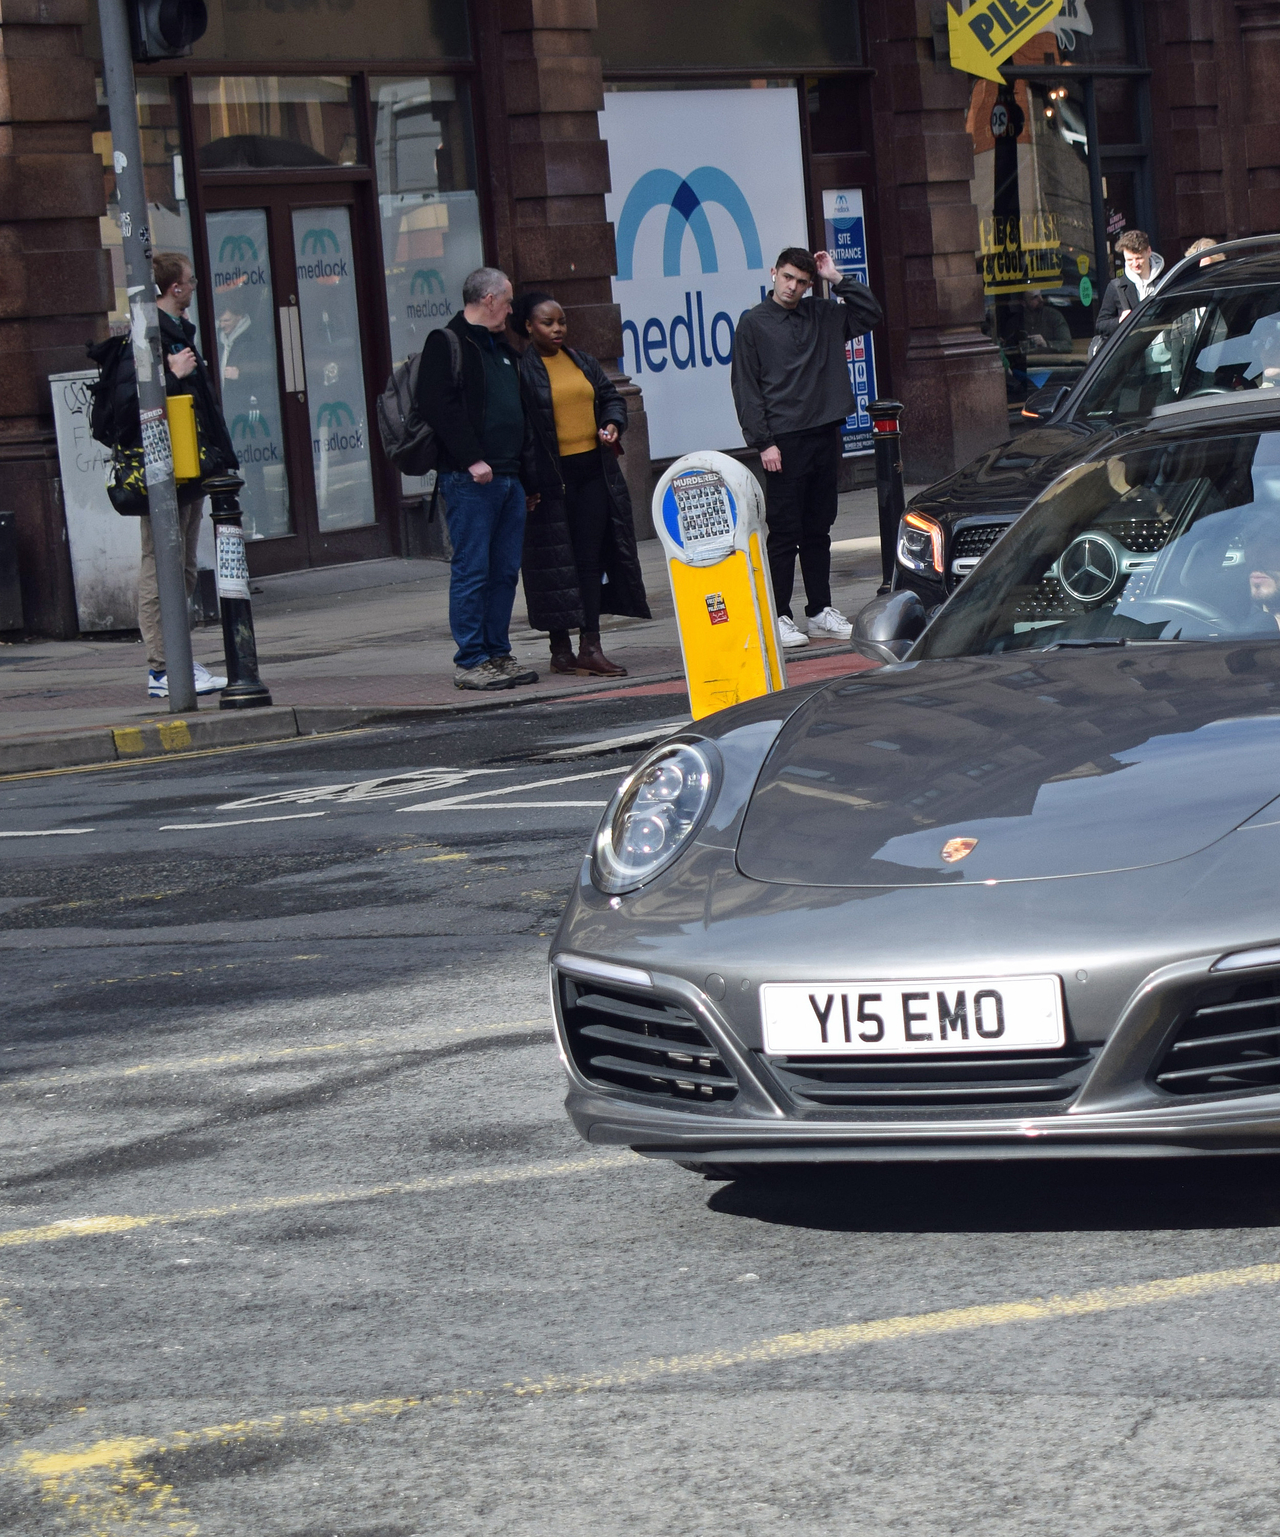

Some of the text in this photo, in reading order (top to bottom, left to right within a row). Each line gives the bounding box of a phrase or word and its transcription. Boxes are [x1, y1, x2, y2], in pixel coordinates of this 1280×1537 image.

[837, 233, 851, 245] SITE
[829, 247, 862, 260] ENTRANCE
[214, 266, 266, 287] medlock
[298, 259, 347, 280] medlock
[406, 299, 453, 319] medlock
[618, 285, 767, 374] edlo
[313, 430, 363, 453] medlock
[237, 442, 278, 465] edlock
[673, 473, 720, 488] MURDERED
[808, 989, 1006, 1043] Y15 EMO
